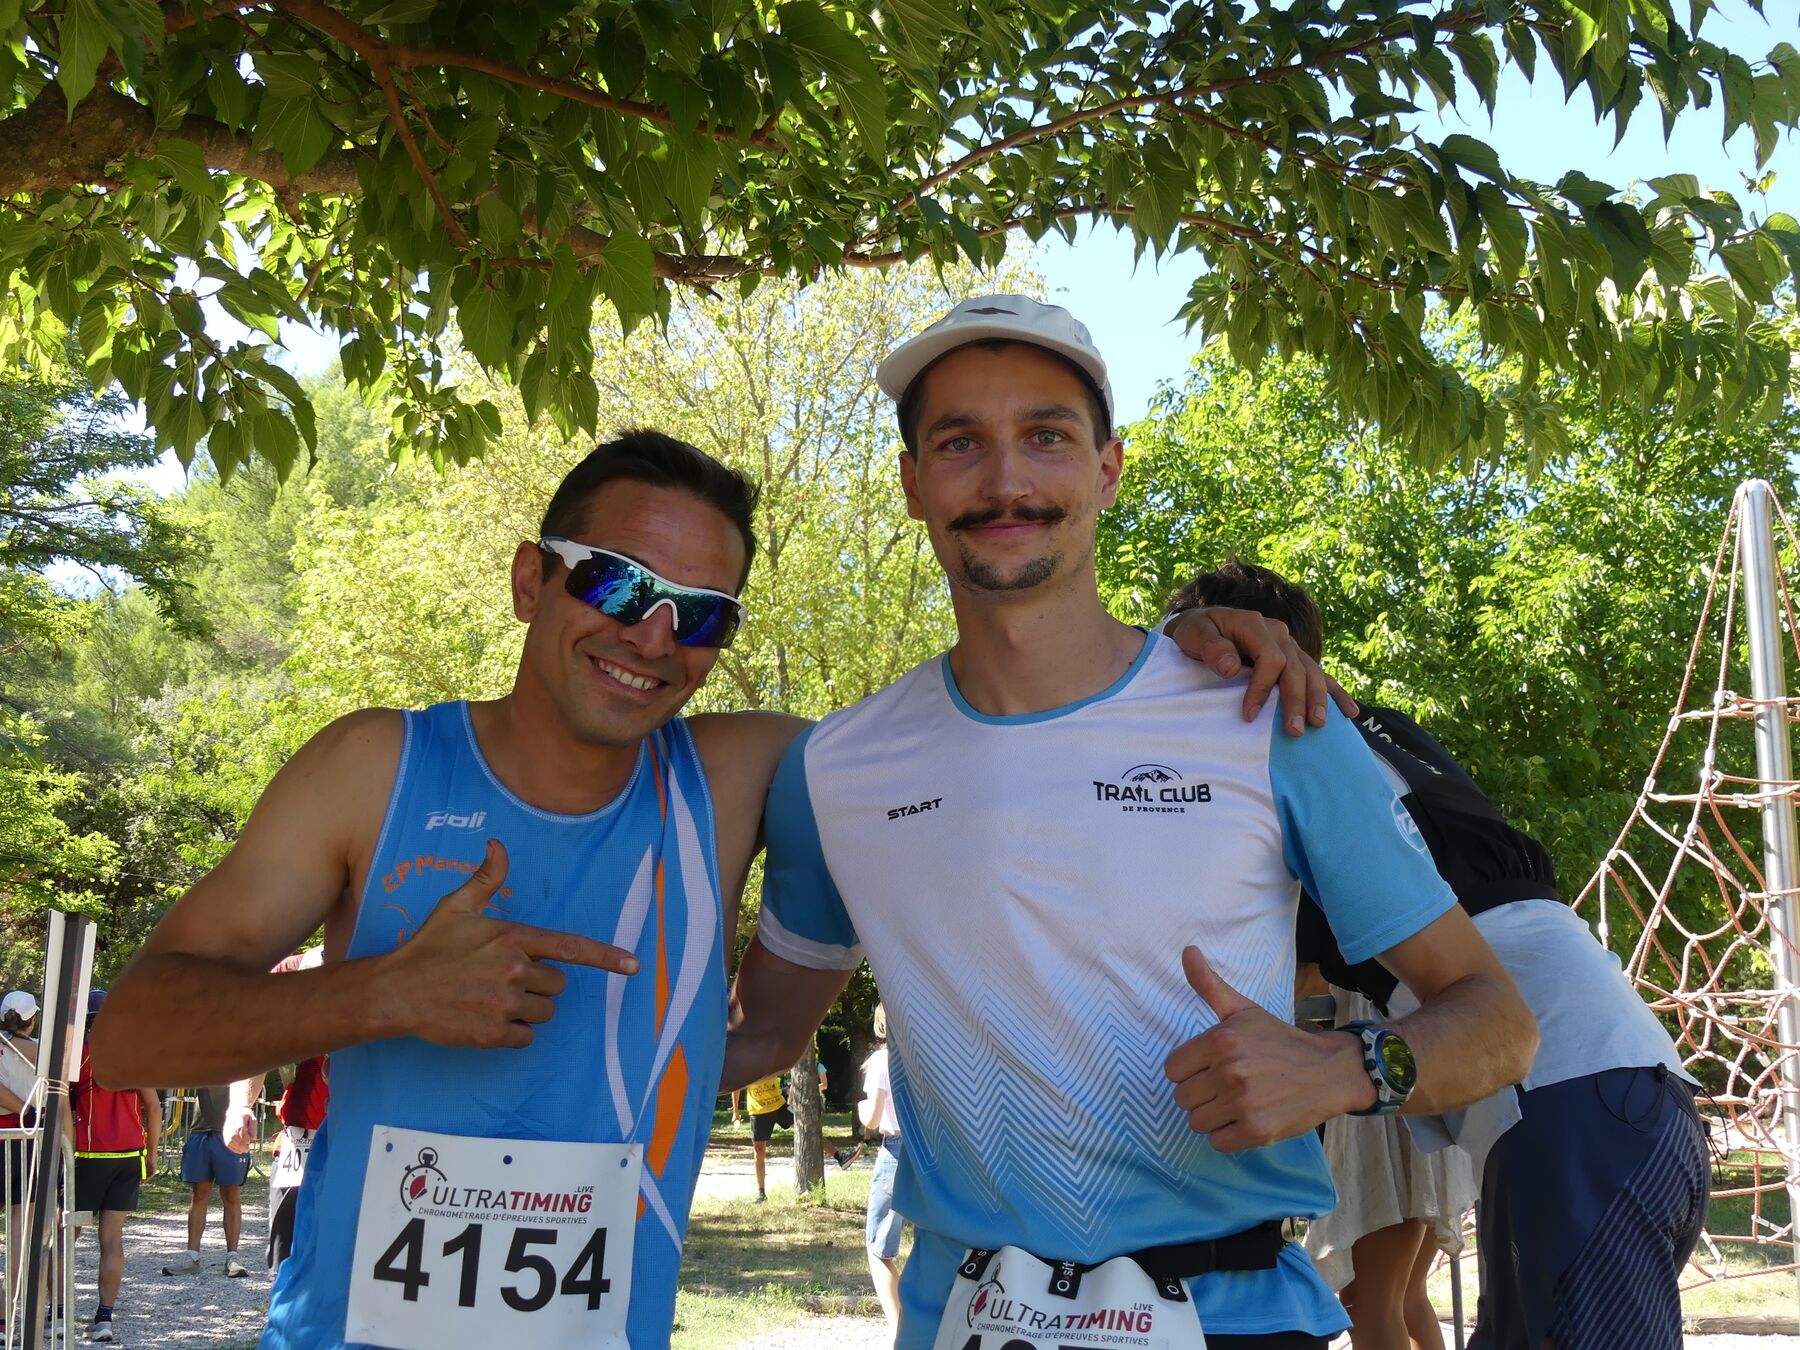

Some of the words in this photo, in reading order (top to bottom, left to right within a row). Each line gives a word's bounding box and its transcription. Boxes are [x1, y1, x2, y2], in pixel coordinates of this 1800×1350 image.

[1093, 781, 1154, 803] TRAIL
[1160, 783, 1212, 803] CLUB
[887, 797, 943, 820] START
[424, 810, 487, 831] poli
[282, 1148, 309, 1172] 40
[432, 1185, 593, 1213] ULTRATIMING
[418, 1207, 491, 1220] CHRONOMÉTRAGE
[492, 1212, 544, 1223] D'ÉPREUVES
[545, 1216, 588, 1225] SPORTIVES
[373, 1217, 611, 1313] 4154
[990, 1298, 1153, 1333] ULTRATIMING
[976, 1322, 1043, 1339] CHRONOMÉTRAGE
[1044, 1331, 1099, 1342] D'ÉPREUVES
[1100, 1334, 1149, 1345] SPORTIVES
